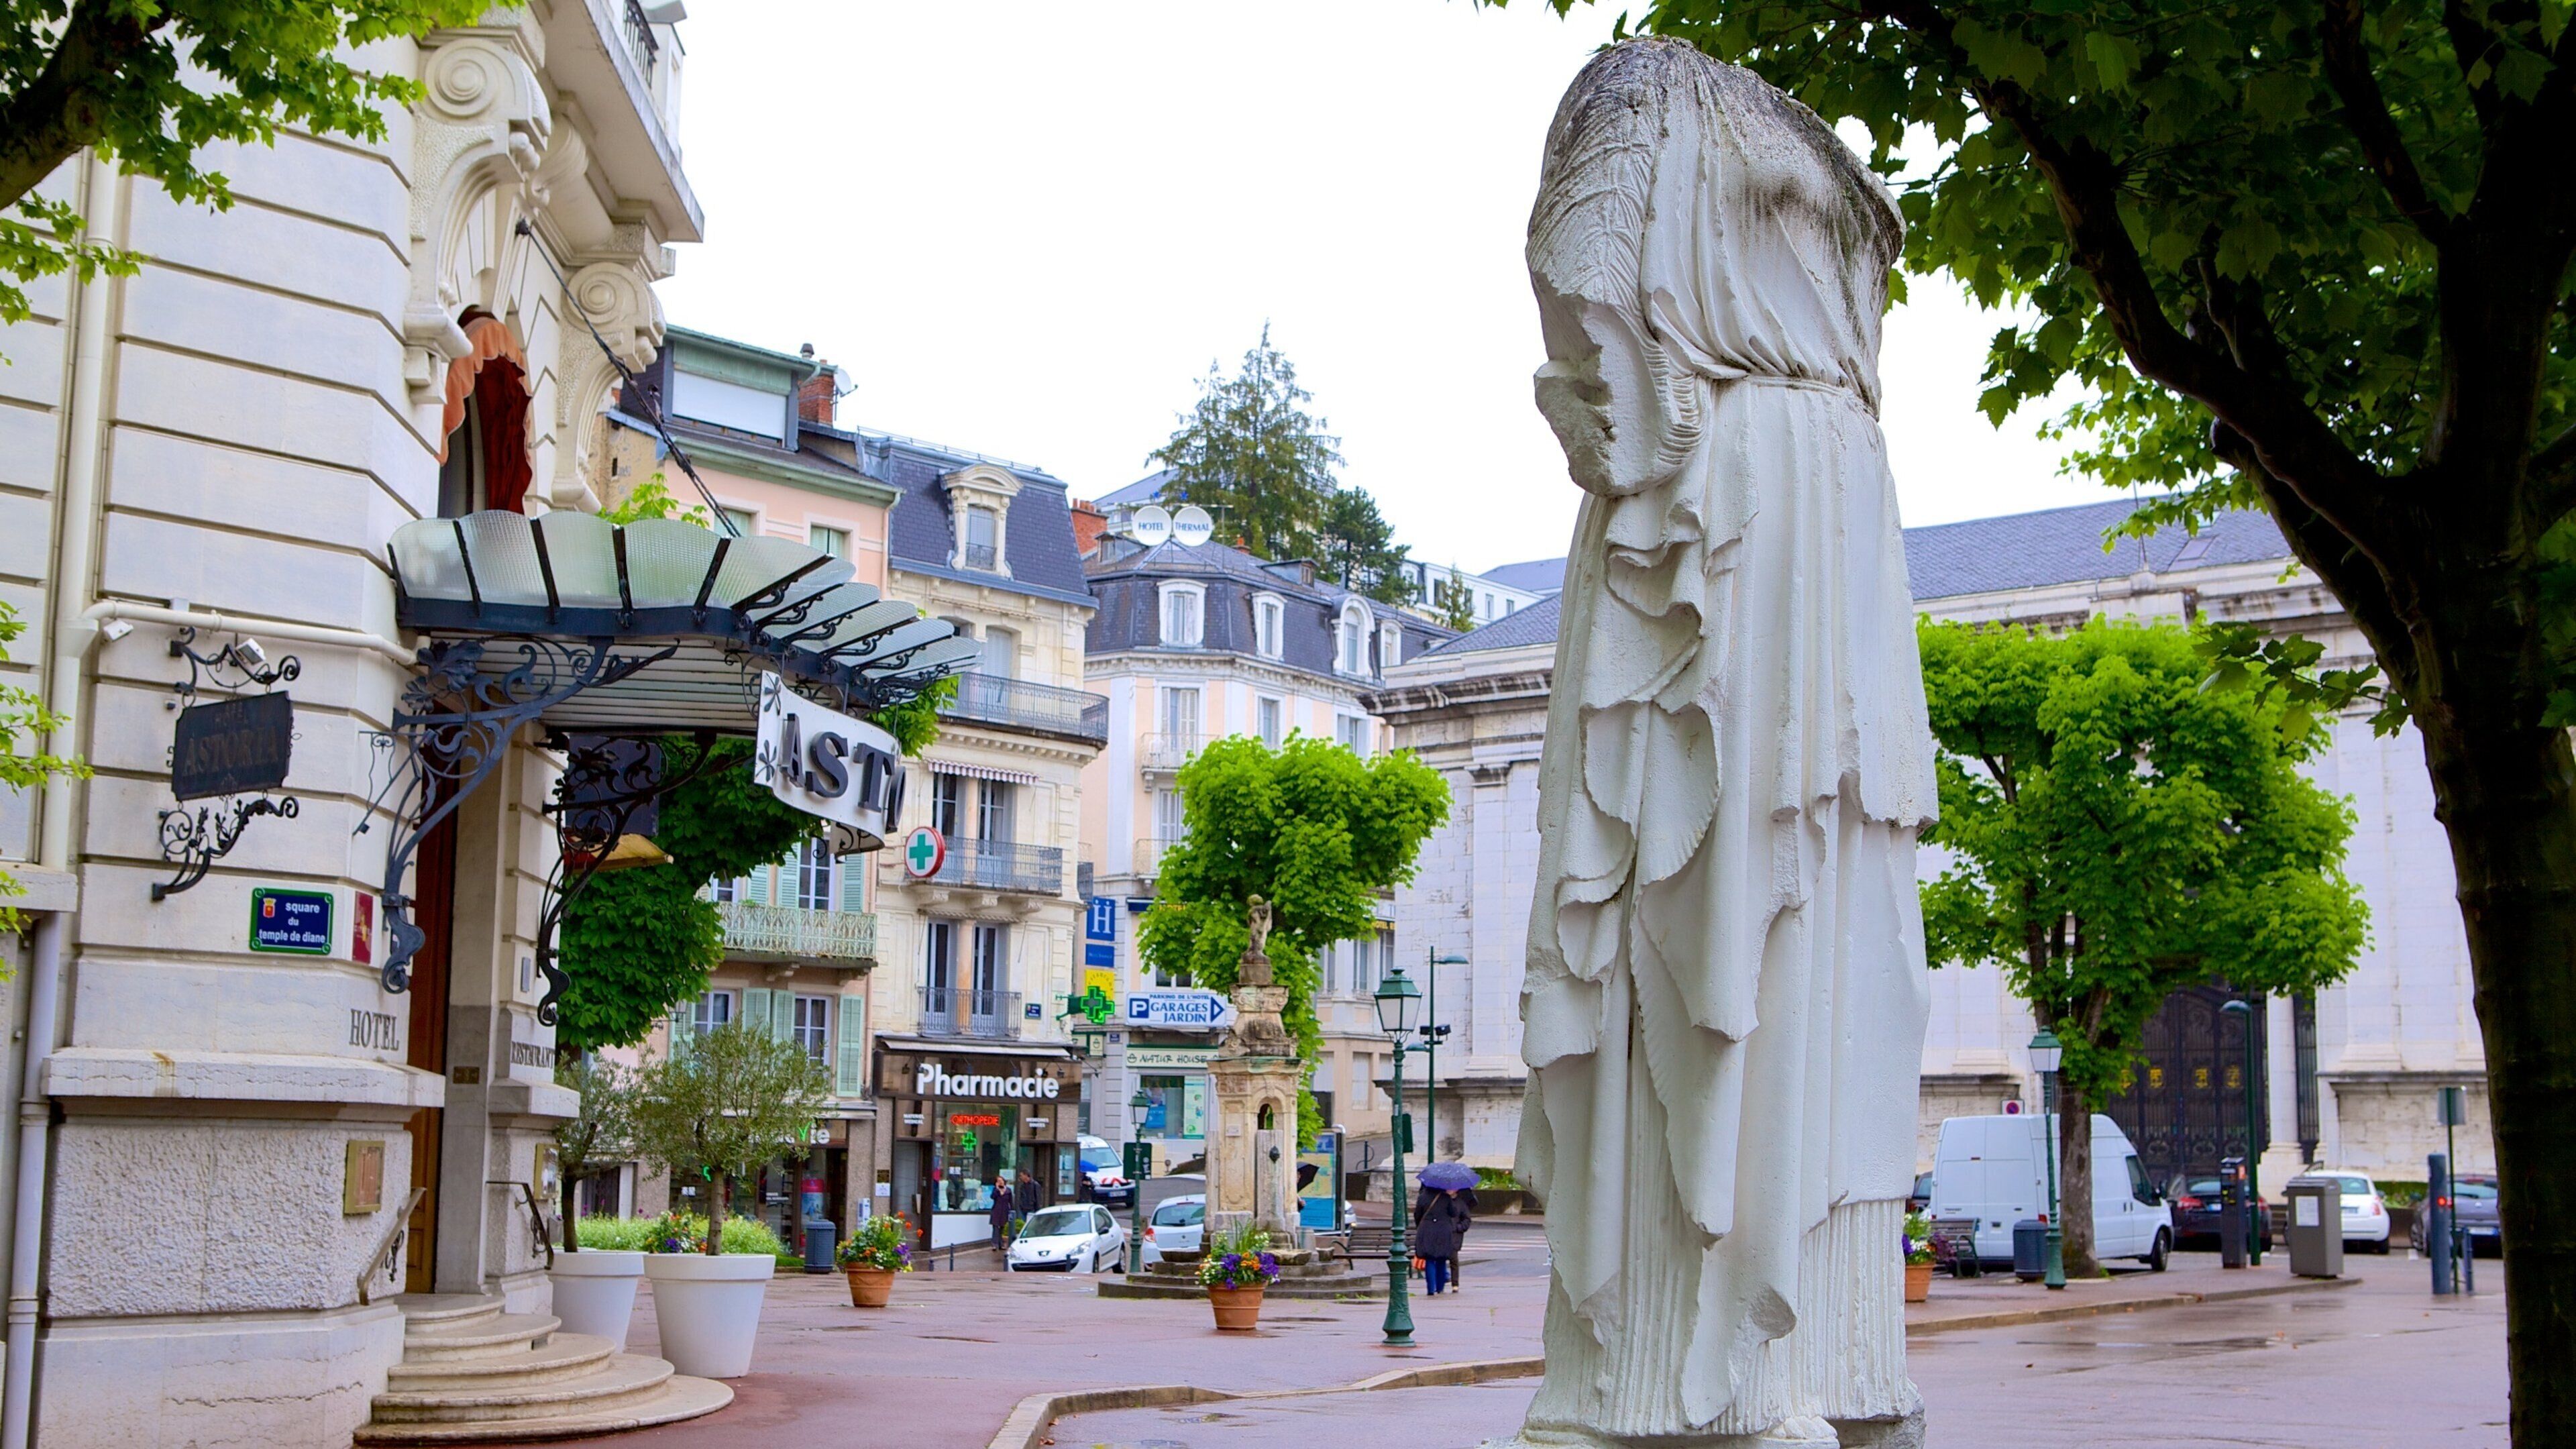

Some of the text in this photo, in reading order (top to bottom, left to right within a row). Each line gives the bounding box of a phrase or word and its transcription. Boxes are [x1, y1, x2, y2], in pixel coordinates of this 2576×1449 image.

[1138, 523, 1210, 531] HOTEL THERMAL
[182, 726, 278, 777] ASTORIA
[285, 902, 320, 914] square
[288, 916, 299, 926] du
[259, 929, 326, 943] temple de diane
[1150, 1002, 1208, 1012] GARAGES
[1163, 1013, 1206, 1023] JARDIN
[349, 1008, 400, 1051] HOTEL
[1140, 1054, 1207, 1063] NATUR HOUSE
[916, 1063, 1059, 1099] Pharmacie
[951, 1114, 1000, 1126] ORTHOPEDIE
